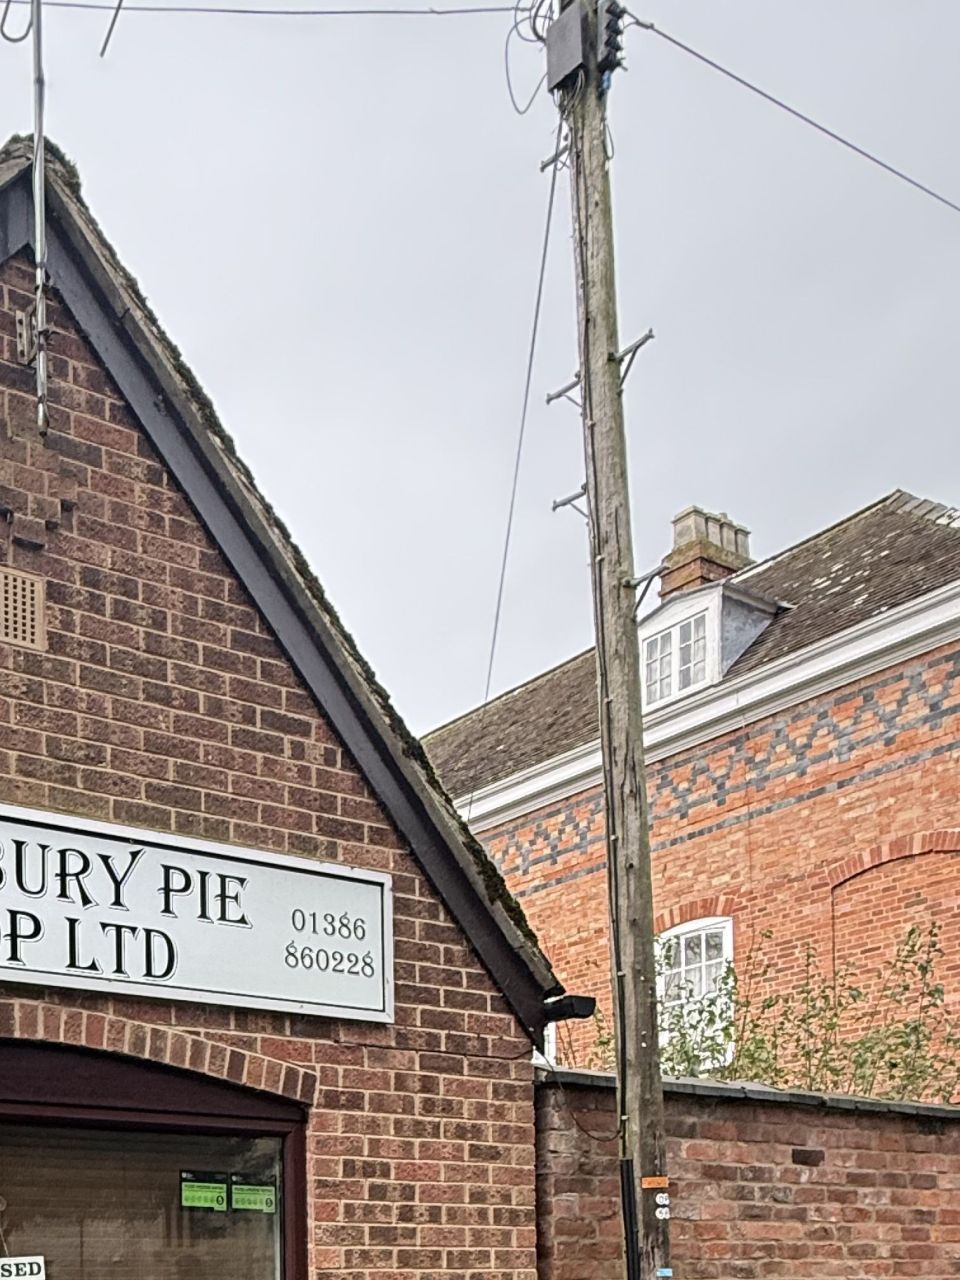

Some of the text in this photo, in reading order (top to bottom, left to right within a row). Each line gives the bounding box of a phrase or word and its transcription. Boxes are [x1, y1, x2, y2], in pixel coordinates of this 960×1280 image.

[157, 864, 253, 929] PIE
[65, 917, 178, 981] LTD
[292, 909, 366, 940] 01386
[285, 940, 375, 978] 860228
